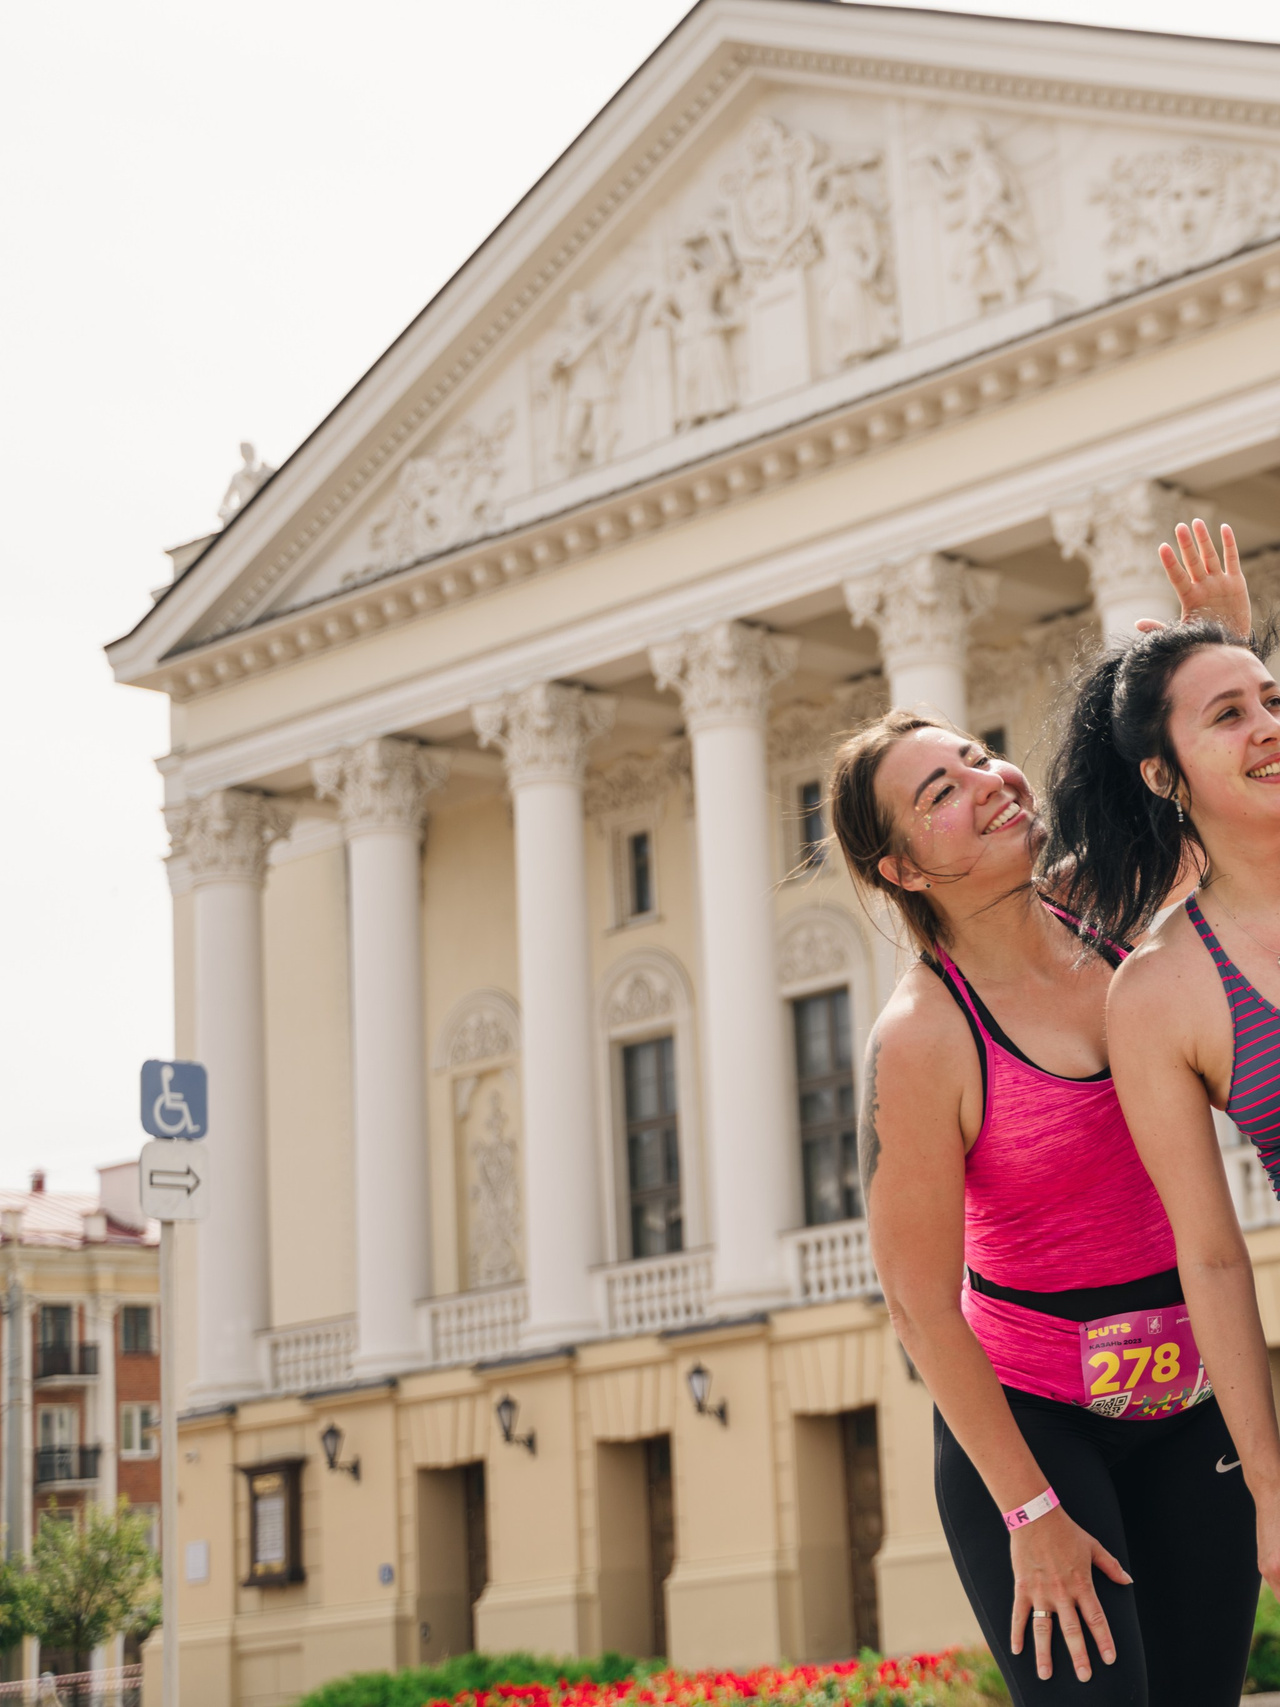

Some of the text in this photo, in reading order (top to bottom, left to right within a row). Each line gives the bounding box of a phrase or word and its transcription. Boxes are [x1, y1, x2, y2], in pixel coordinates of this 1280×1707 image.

[1088, 1322, 1131, 1340] RUTS
[1089, 1338, 1142, 1350] КАЗАНЬ 2023
[1088, 1342, 1180, 1396] 278
